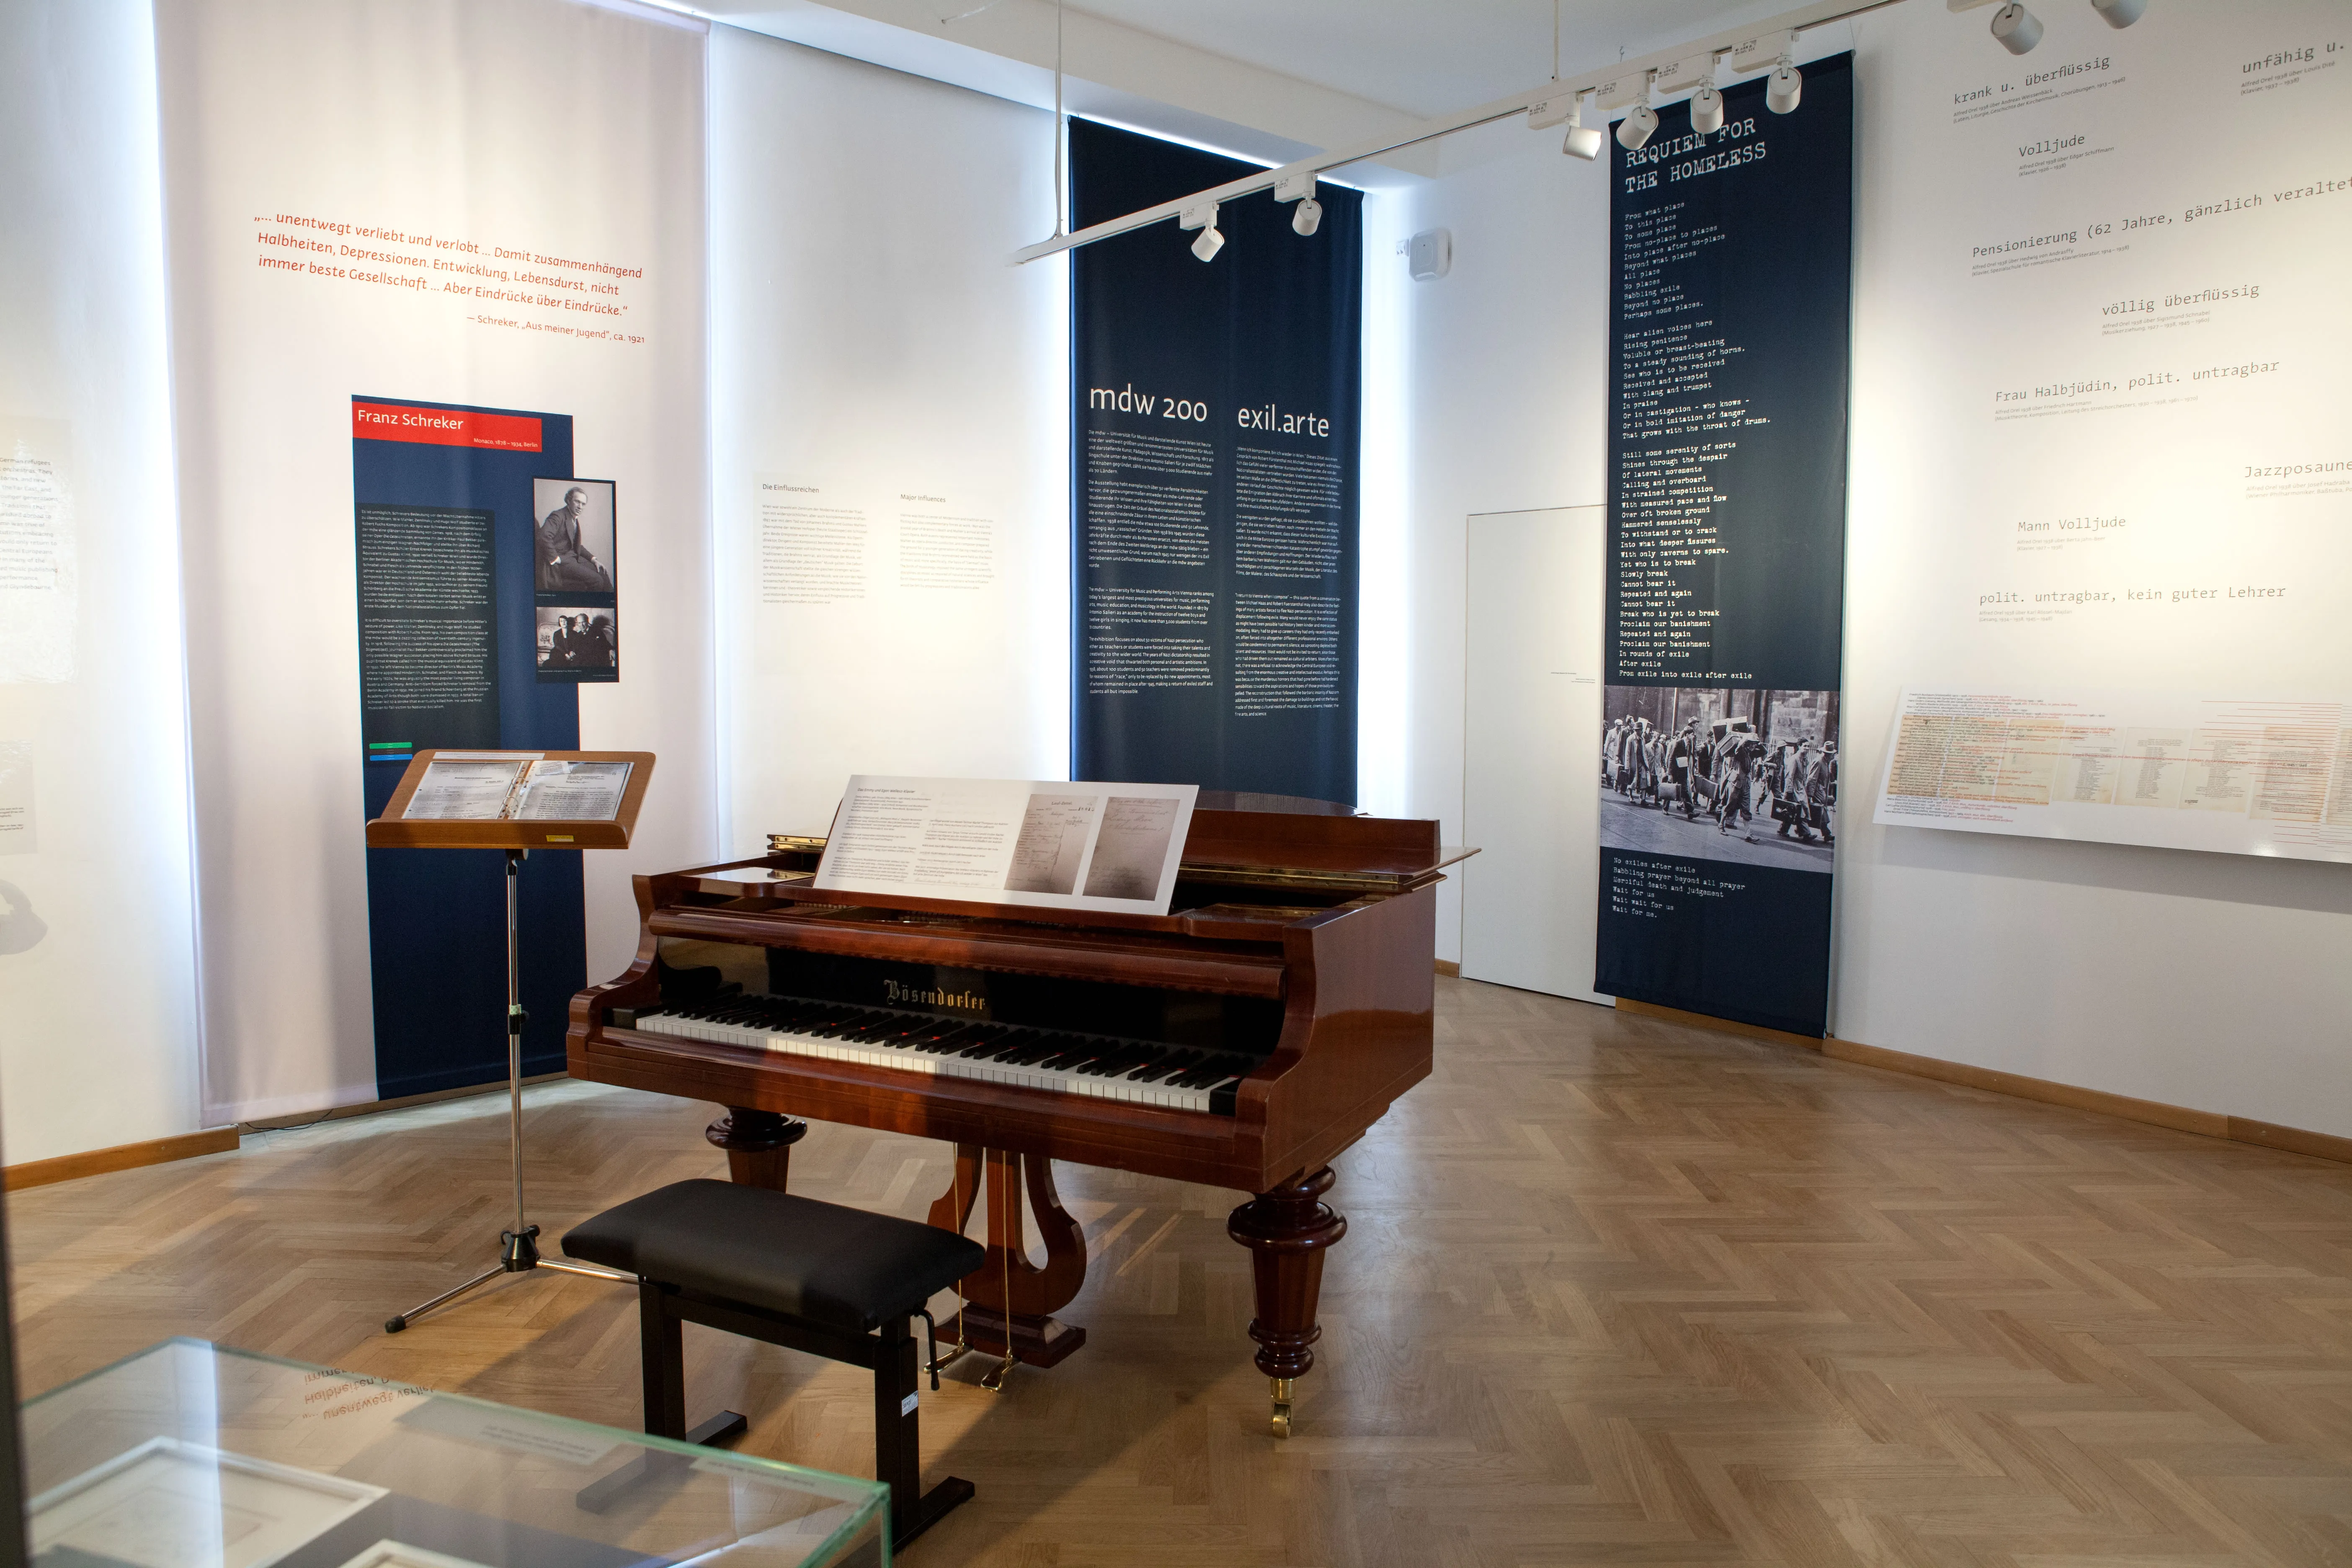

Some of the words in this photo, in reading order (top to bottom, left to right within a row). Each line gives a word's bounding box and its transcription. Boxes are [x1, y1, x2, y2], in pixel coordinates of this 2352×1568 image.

[2243, 48, 2314, 73] unfähig
[2327, 42, 2344, 53] u.
[1955, 85, 1992, 104] krank
[2001, 83, 2014, 92] u.
[2026, 57, 2110, 86] überflüssig
[2021, 88, 2053, 100] Weissenbäck
[1626, 132, 1707, 168] REQUIEM
[1718, 118, 1756, 142] FOR
[2019, 134, 2084, 157] Volljude
[2084, 147, 2114, 157] Schiffmann
[1625, 170, 1658, 193] THE
[1670, 141, 1766, 182] HOMELESS
[1645, 207, 1661, 216] what
[1664, 202, 1684, 213] place
[1973, 231, 2077, 258] Pensionierung
[2088, 224, 2111, 239] (62
[2122, 215, 2172, 230] Jahre,
[2185, 194, 2262, 222] gänzlich
[276, 214, 351, 236] unentwegt
[356, 227, 405, 242] verliebt
[409, 235, 432, 246] und
[436, 239, 479, 254] verlobt
[495, 247, 531, 261] Damit
[534, 255, 642, 279] zusammenhängend
[258, 232, 335, 256] Halbheiten,
[340, 245, 429, 268] Depressionen.
[433, 259, 510, 282] Entwicklung,
[514, 271, 587, 293] Lebensdurst,
[591, 282, 619, 295] nicht
[259, 255, 305, 272] immer
[309, 261, 346, 278] beste
[349, 269, 427, 291] Gesellschaft
[444, 282, 472, 295] Aber
[475, 286, 533, 304] Eindrücke
[537, 294, 562, 307] über
[1624, 289, 1657, 300] Babbling
[1660, 285, 1680, 293] exile
[2102, 299, 2155, 315] völlig
[2165, 284, 2259, 307] überflüssig
[477, 315, 519, 329] Schreker,
[544, 325, 575, 335] meiner
[1996, 391, 2026, 402] Frau
[2035, 380, 2117, 397] Halbjüdin,
[2129, 372, 2179, 391] polit.
[2193, 362, 2280, 380] untragbar
[1091, 383, 1155, 415] mdw
[1163, 398, 1207, 422] 200
[358, 410, 398, 424] Franz
[402, 413, 464, 429] Schreker
[1238, 404, 1329, 437] exil.arte
[1641, 430, 1662, 439] grows
[1703, 422, 1728, 430] throat
[774, 484, 819, 493] Einflussreichen
[2018, 521, 2049, 532] Mann
[2058, 516, 2126, 531] Volljude
[1980, 592, 2024, 606] polit.
[2035, 590, 2115, 604] untragbar,
[2128, 589, 2161, 600] kein
[2172, 588, 2218, 602] guter
[2229, 586, 2286, 598] Lehrer
[1613, 867, 1644, 879] Babbling
[1674, 875, 1700, 884] beyond
[1720, 882, 1745, 891] prayer
[1613, 876, 1643, 886] Merciful
[1648, 881, 1667, 890] death
[1687, 887, 1724, 897] judgement
[884, 980, 985, 1010] Bösendorfer
